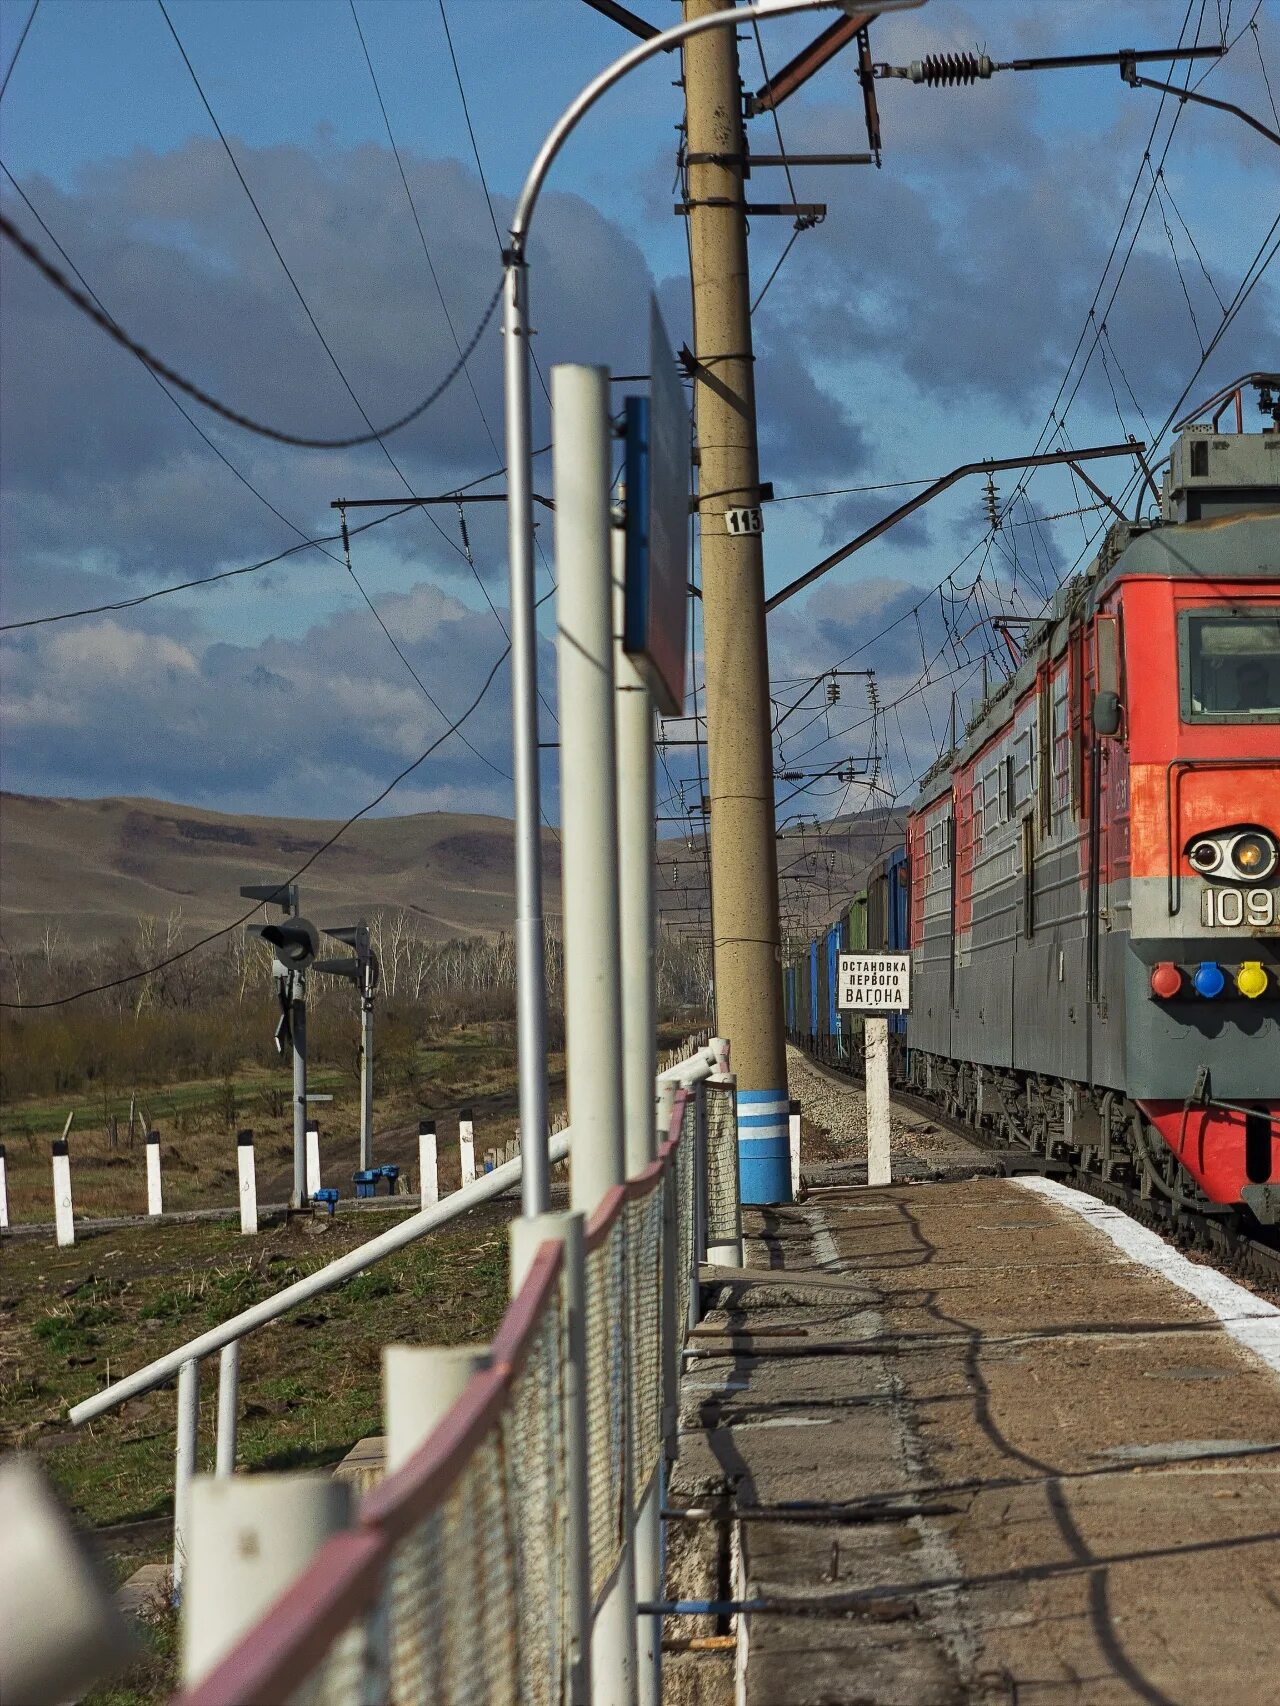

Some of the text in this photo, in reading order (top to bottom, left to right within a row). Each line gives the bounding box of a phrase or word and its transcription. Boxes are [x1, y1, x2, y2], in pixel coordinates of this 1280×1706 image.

[730, 510, 761, 532] 113
[842, 961, 907, 972] ОСТАНОВКА
[849, 974, 899, 986] ПЕРВОГО
[846, 988, 903, 1003] ВАГОНА
